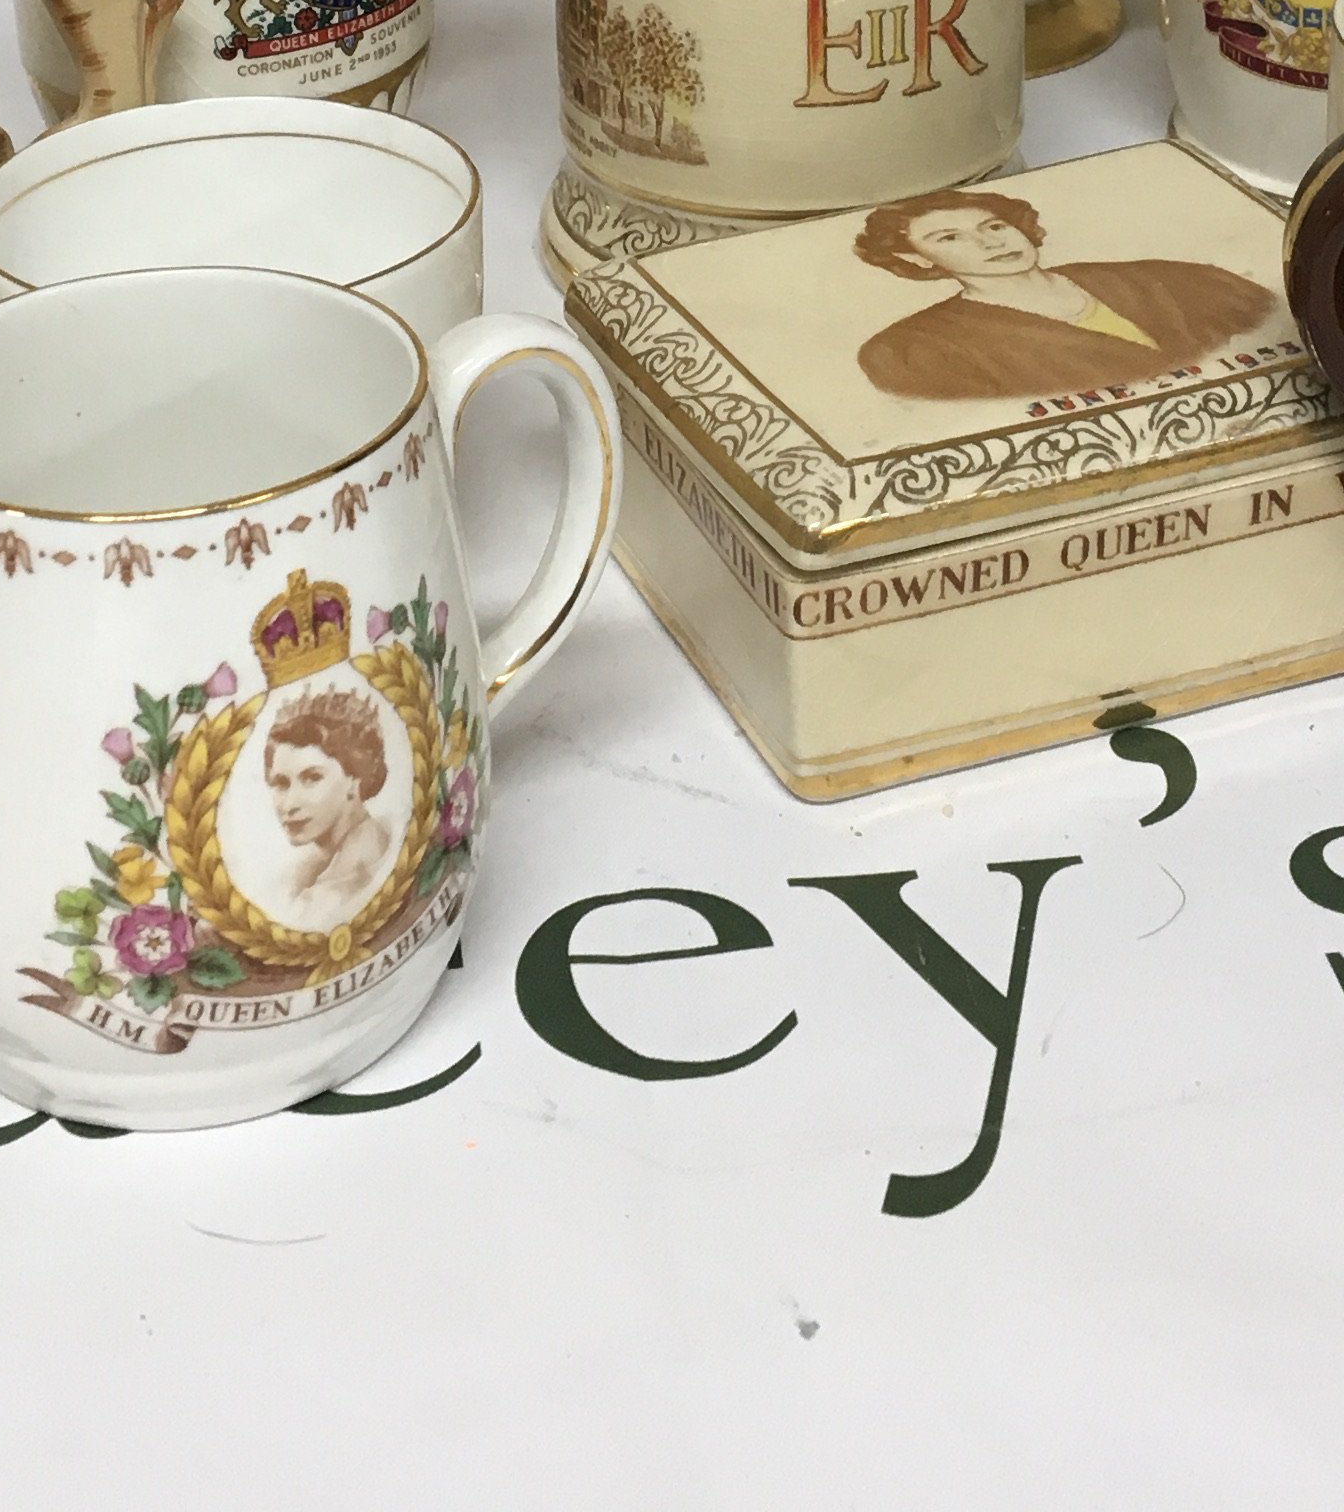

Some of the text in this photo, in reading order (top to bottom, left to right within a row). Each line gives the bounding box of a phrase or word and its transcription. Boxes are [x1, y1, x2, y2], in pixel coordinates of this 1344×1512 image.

[237, 5, 421, 77] CORONATION SOUVENIR
[269, 33, 320, 52] QUEEN
[327, 4, 397, 40] ELIZABETH
[298, 63, 343, 85] JUNE
[373, 39, 397, 62] 1953
[643, 422, 756, 589] ELIZABETH
[793, 548, 1030, 630] CROWNED
[1061, 505, 1211, 573] QUEEN
[1249, 483, 1296, 528] IN
[185, 996, 294, 1024] QUEEN
[313, 887, 454, 1008] ELIZABETH
